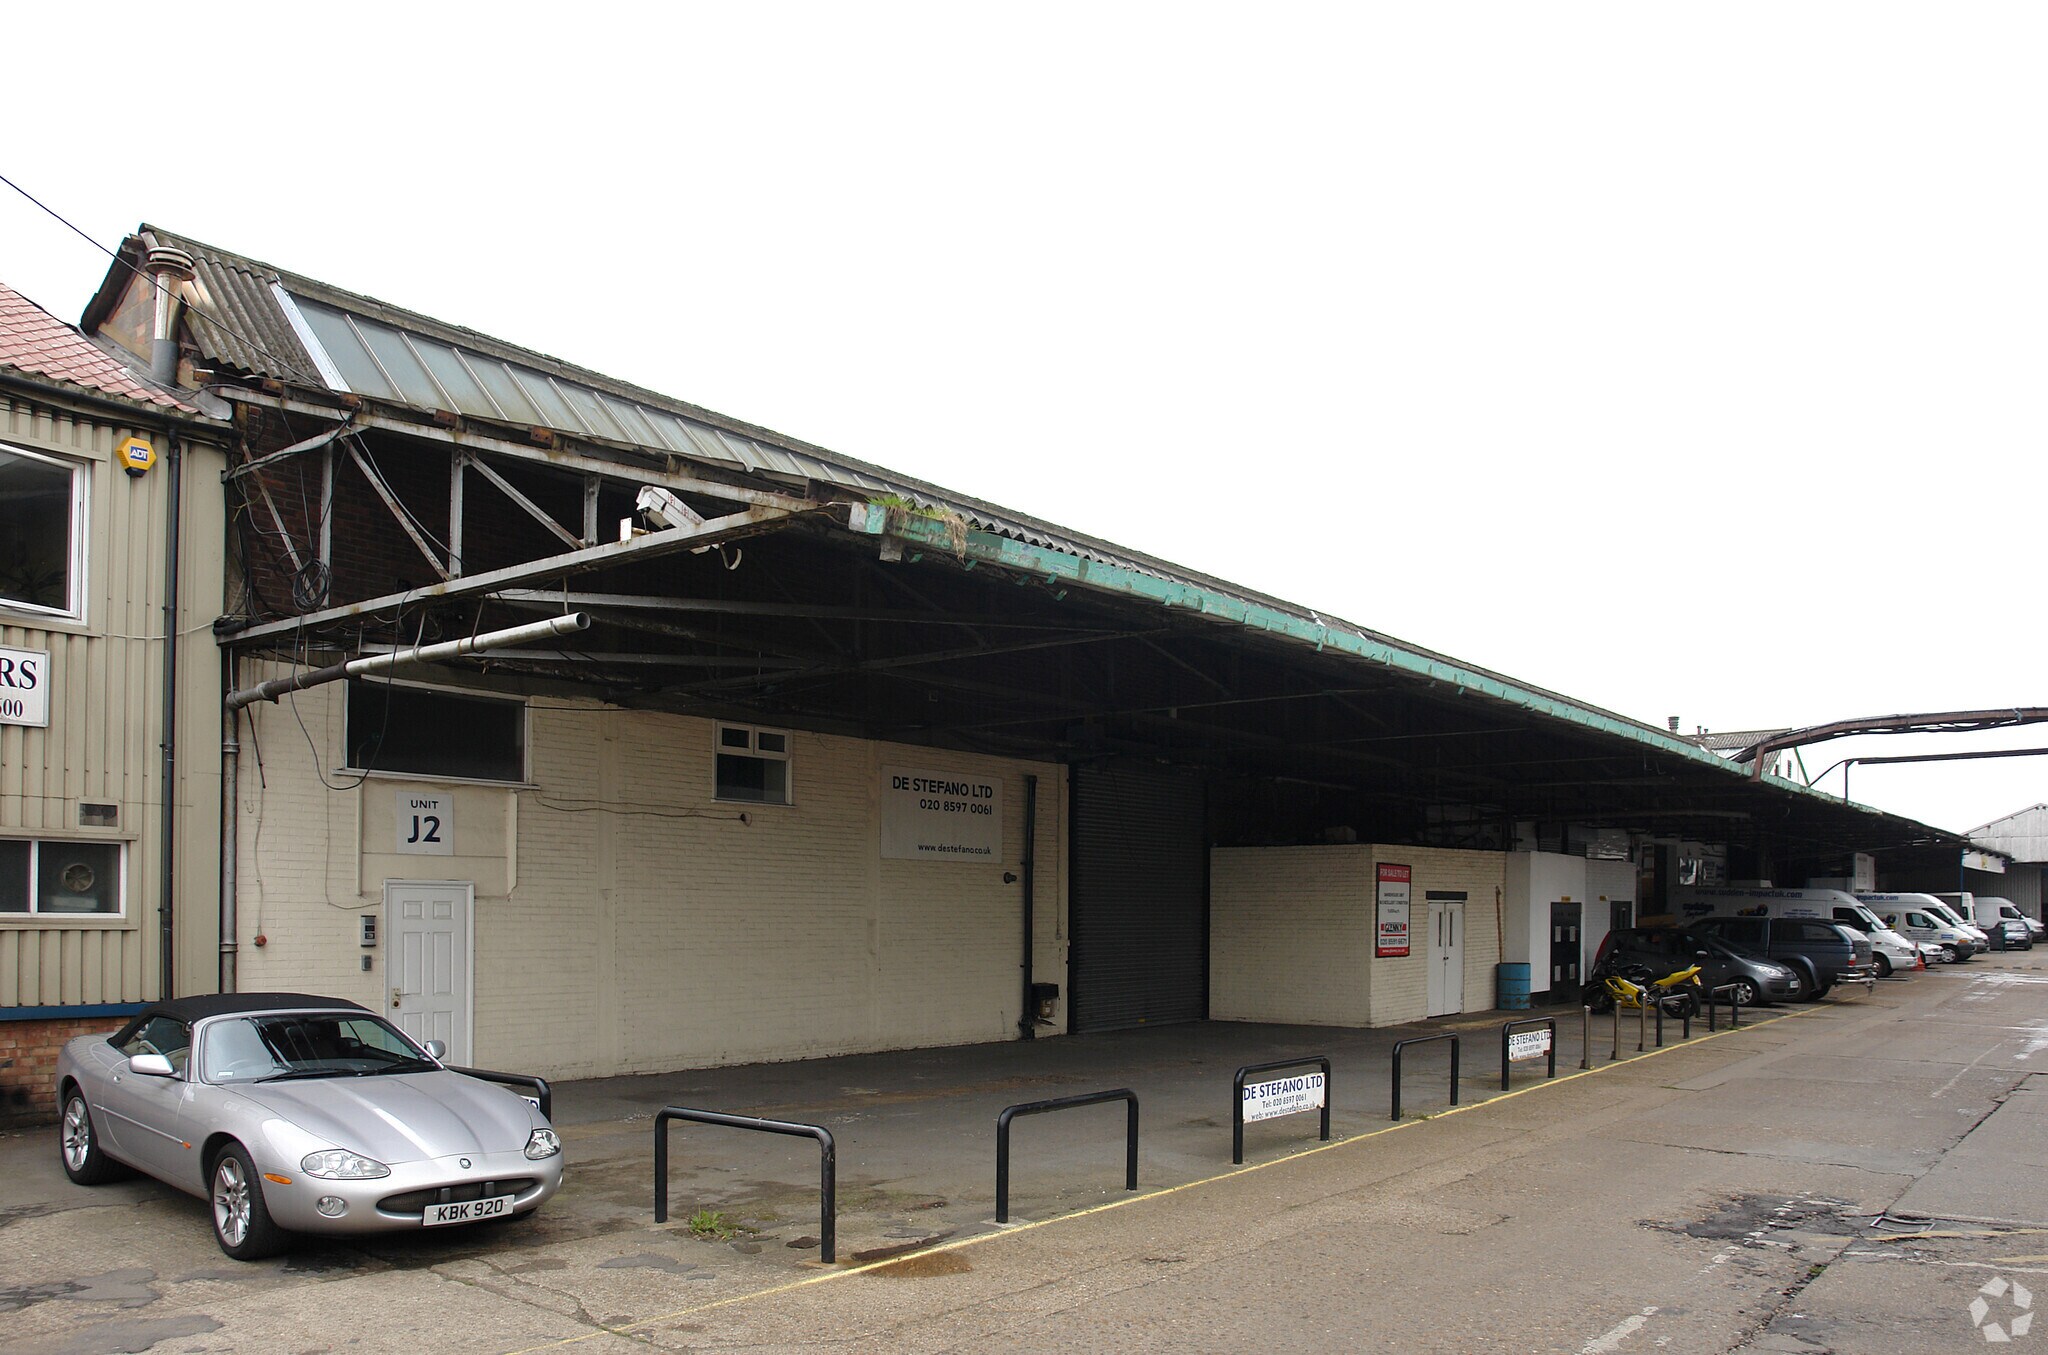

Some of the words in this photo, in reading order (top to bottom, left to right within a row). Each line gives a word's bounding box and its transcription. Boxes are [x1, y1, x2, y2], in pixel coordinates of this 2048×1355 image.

[130, 449, 148, 460] ADT
[0, 657, 37, 690] RS
[0, 698, 23, 717] 00
[893, 776, 909, 790] DE
[913, 778, 969, 796] STEFANO
[972, 784, 993, 798] LTD
[410, 799, 439, 809] UNIT
[920, 799, 940, 810] 020
[943, 801, 967, 812] 8597
[970, 803, 992, 815] 0061
[407, 815, 441, 843] J2
[1516, 1033, 1540, 1045] STEFANO
[1244, 1087, 1256, 1100] DE
[1259, 1078, 1303, 1098] STEFANO
[1306, 1075, 1323, 1089] LTD
[1262, 1100, 1272, 1109] Tel:
[1273, 1097, 1282, 1107] 020
[1295, 1093, 1307, 1102] 0061
[1251, 1111, 1263, 1120] web:
[437, 1204, 470, 1221] KBK
[474, 1199, 504, 1216] 920
